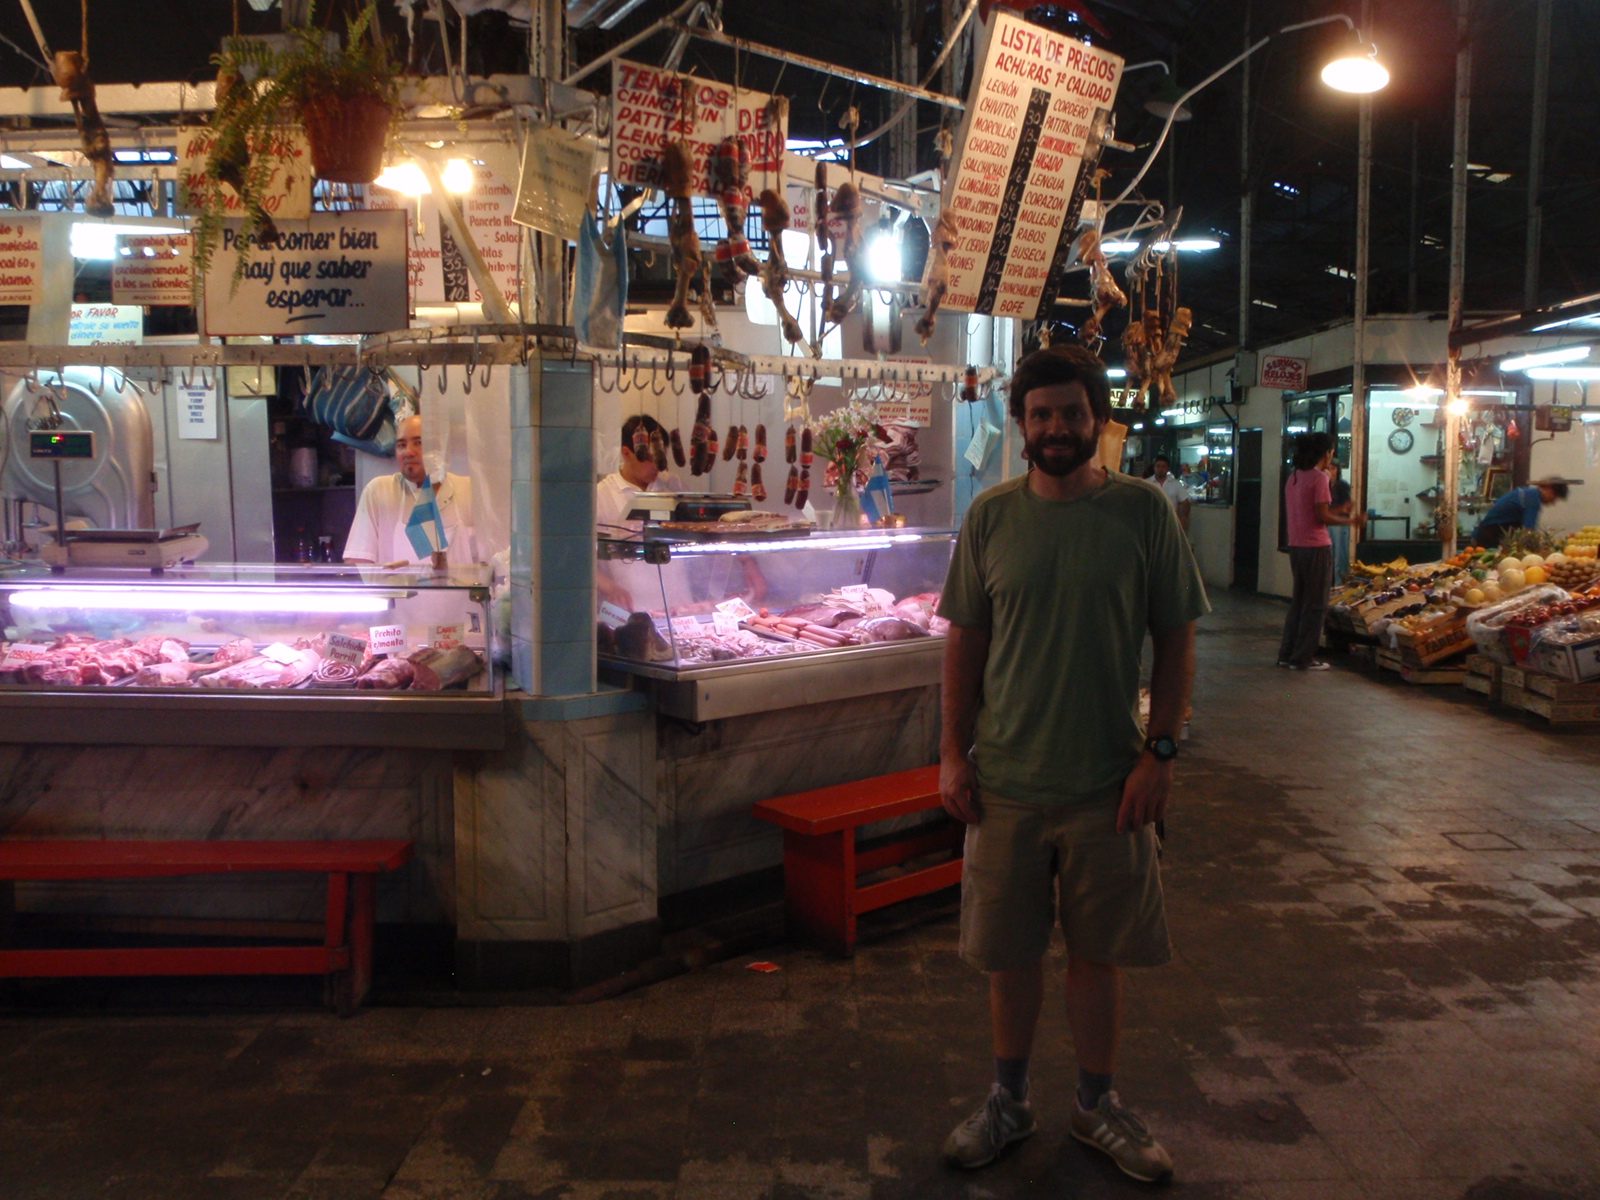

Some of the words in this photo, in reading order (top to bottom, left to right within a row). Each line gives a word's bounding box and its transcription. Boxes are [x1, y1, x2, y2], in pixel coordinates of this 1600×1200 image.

[1000, 24, 1042, 58] LISTA
[1045, 38, 1064, 65] DE
[1066, 46, 1117, 82] PRECIOS
[986, 78, 1019, 99] LECHÓN
[995, 52, 1052, 85] ACHURAS
[1066, 76, 1112, 104] CALIDAD
[979, 96, 1019, 119] CHIVITOS
[1053, 98, 1089, 119] CORDERO
[617, 107, 695, 135] PATITAS
[738, 108, 768, 132] DE
[973, 117, 1018, 140] MORCILLAS
[1044, 115, 1072, 135] PATITAS
[968, 137, 1009, 159] CHORIZOS
[963, 156, 1008, 178] SALCHICHAS
[1033, 152, 1064, 172] HIGADO
[959, 176, 1000, 198] LONGANIZA
[1030, 172, 1065, 192] LENGUA
[1024, 191, 1066, 211] CORAZON
[469, 215, 501, 227] Panceta
[1019, 209, 1061, 229] MOLLEJAS
[278, 230, 335, 251] comer
[339, 227, 379, 251] bien
[1016, 228, 1047, 245] RABOS
[1011, 245, 1047, 262] BUSECA
[280, 261, 312, 285] que
[316, 255, 372, 280] saber
[86, 307, 118, 318] FAVOR
[1000, 299, 1025, 314] BOFE
